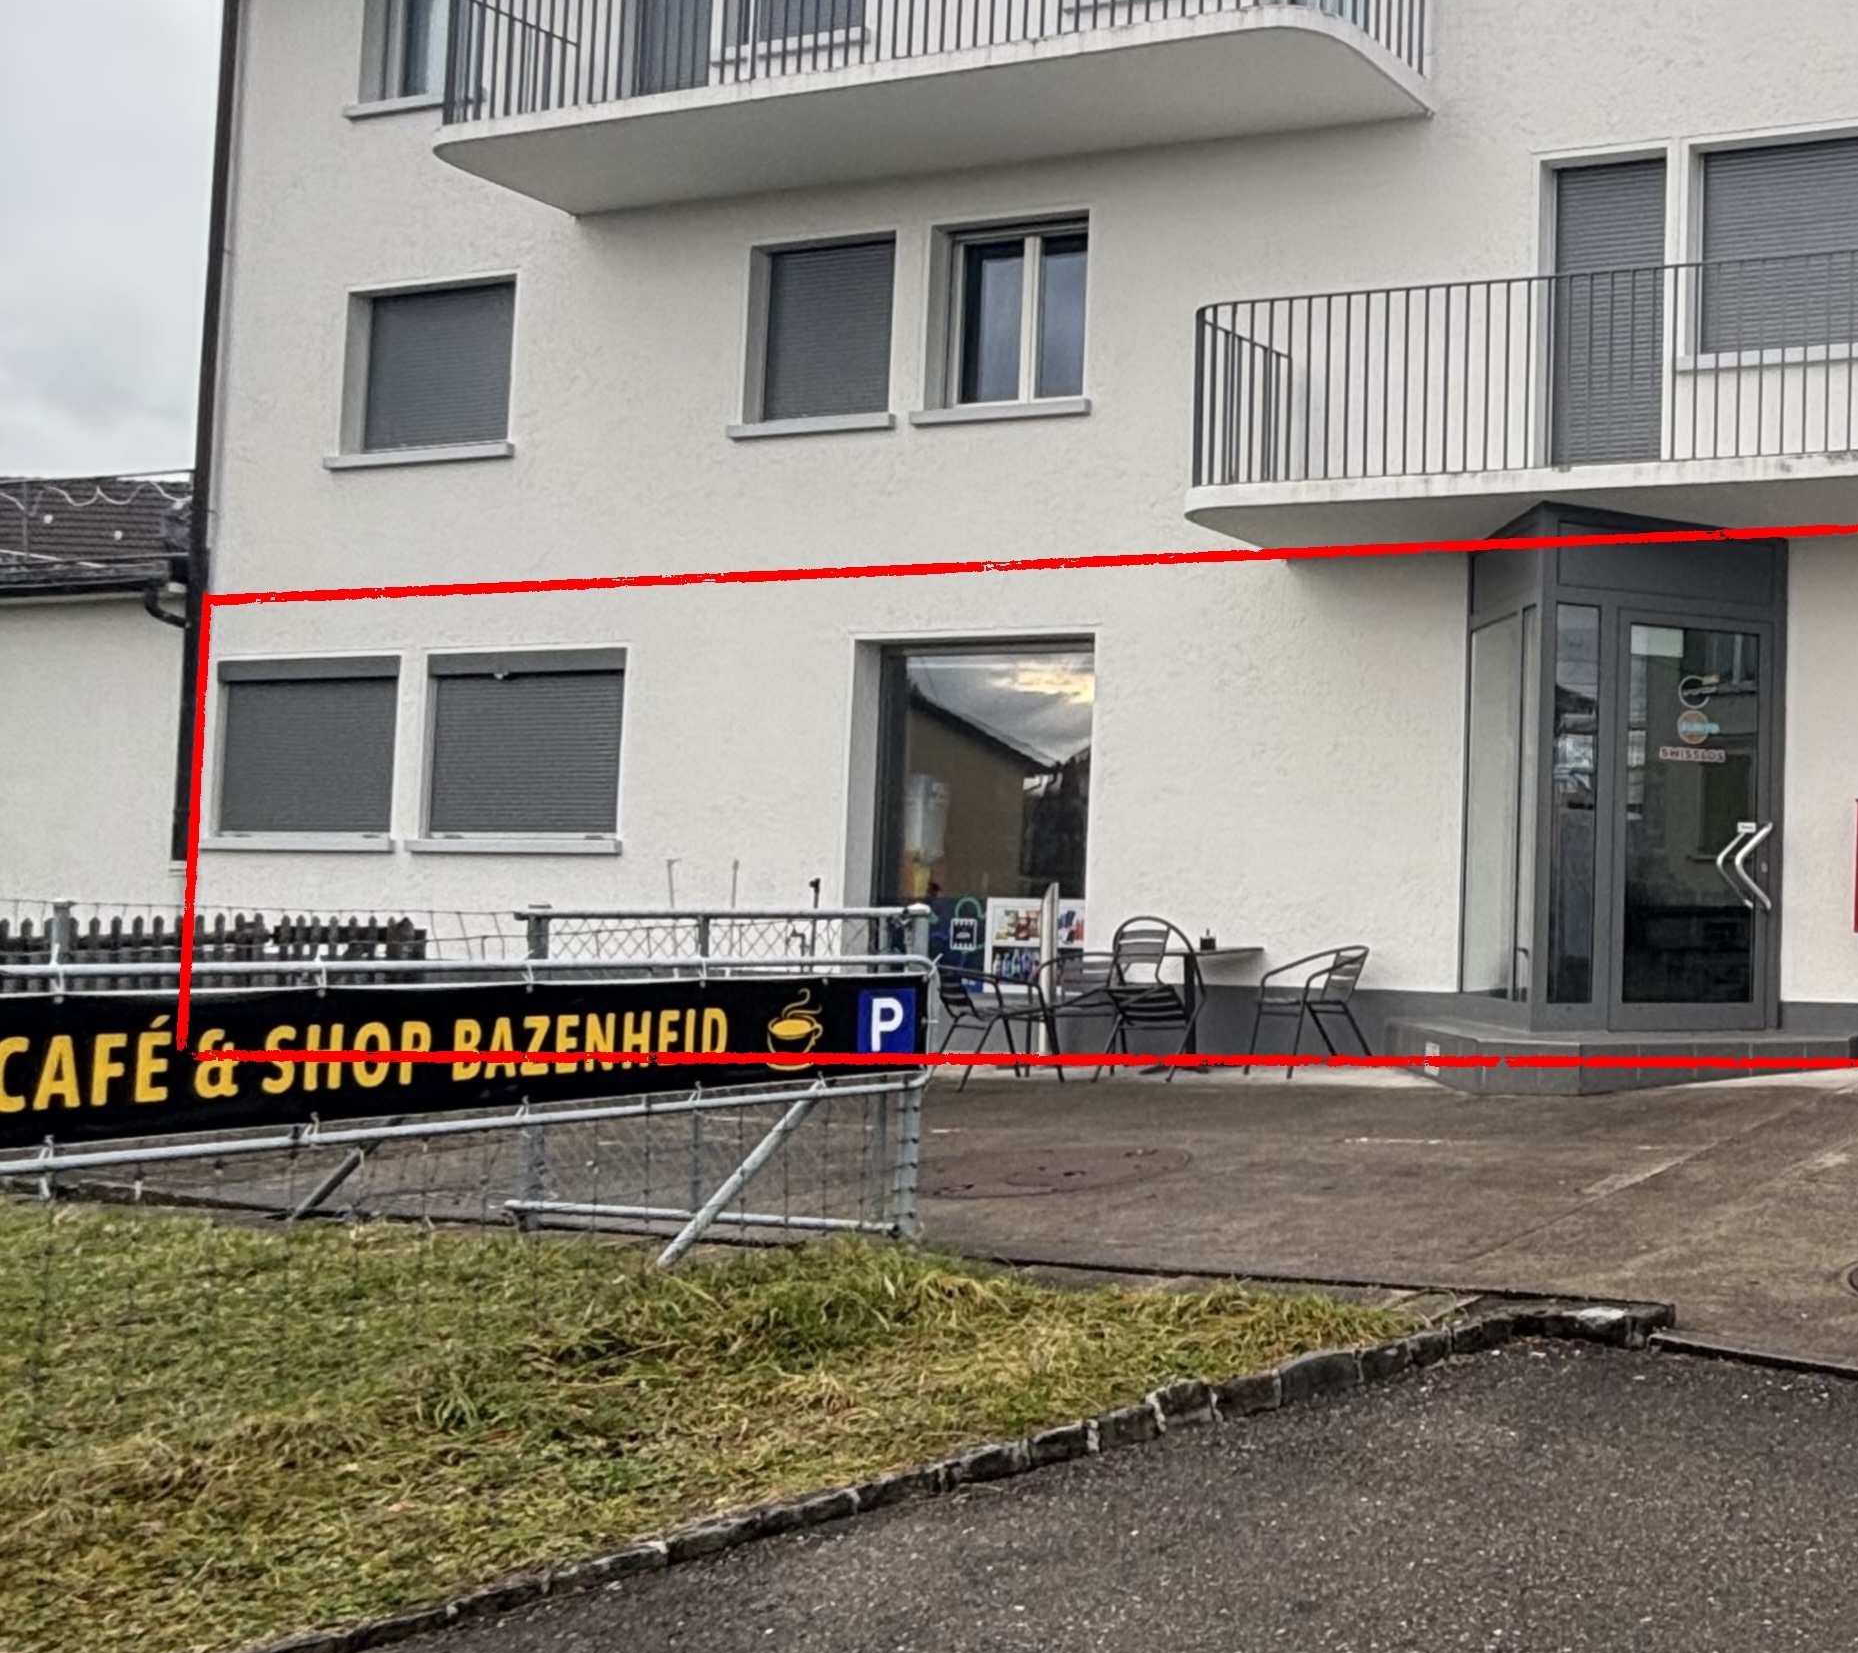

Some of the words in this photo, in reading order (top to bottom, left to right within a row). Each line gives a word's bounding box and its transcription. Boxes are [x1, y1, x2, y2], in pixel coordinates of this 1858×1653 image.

[1661, 748, 1725, 761] SWISSLOS
[871, 996, 904, 1053] P
[0, 1015, 172, 1113] CAFÉ
[194, 1028, 239, 1099] &
[261, 1020, 432, 1094] SHOP
[452, 1007, 728, 1082] BAZENHEID
